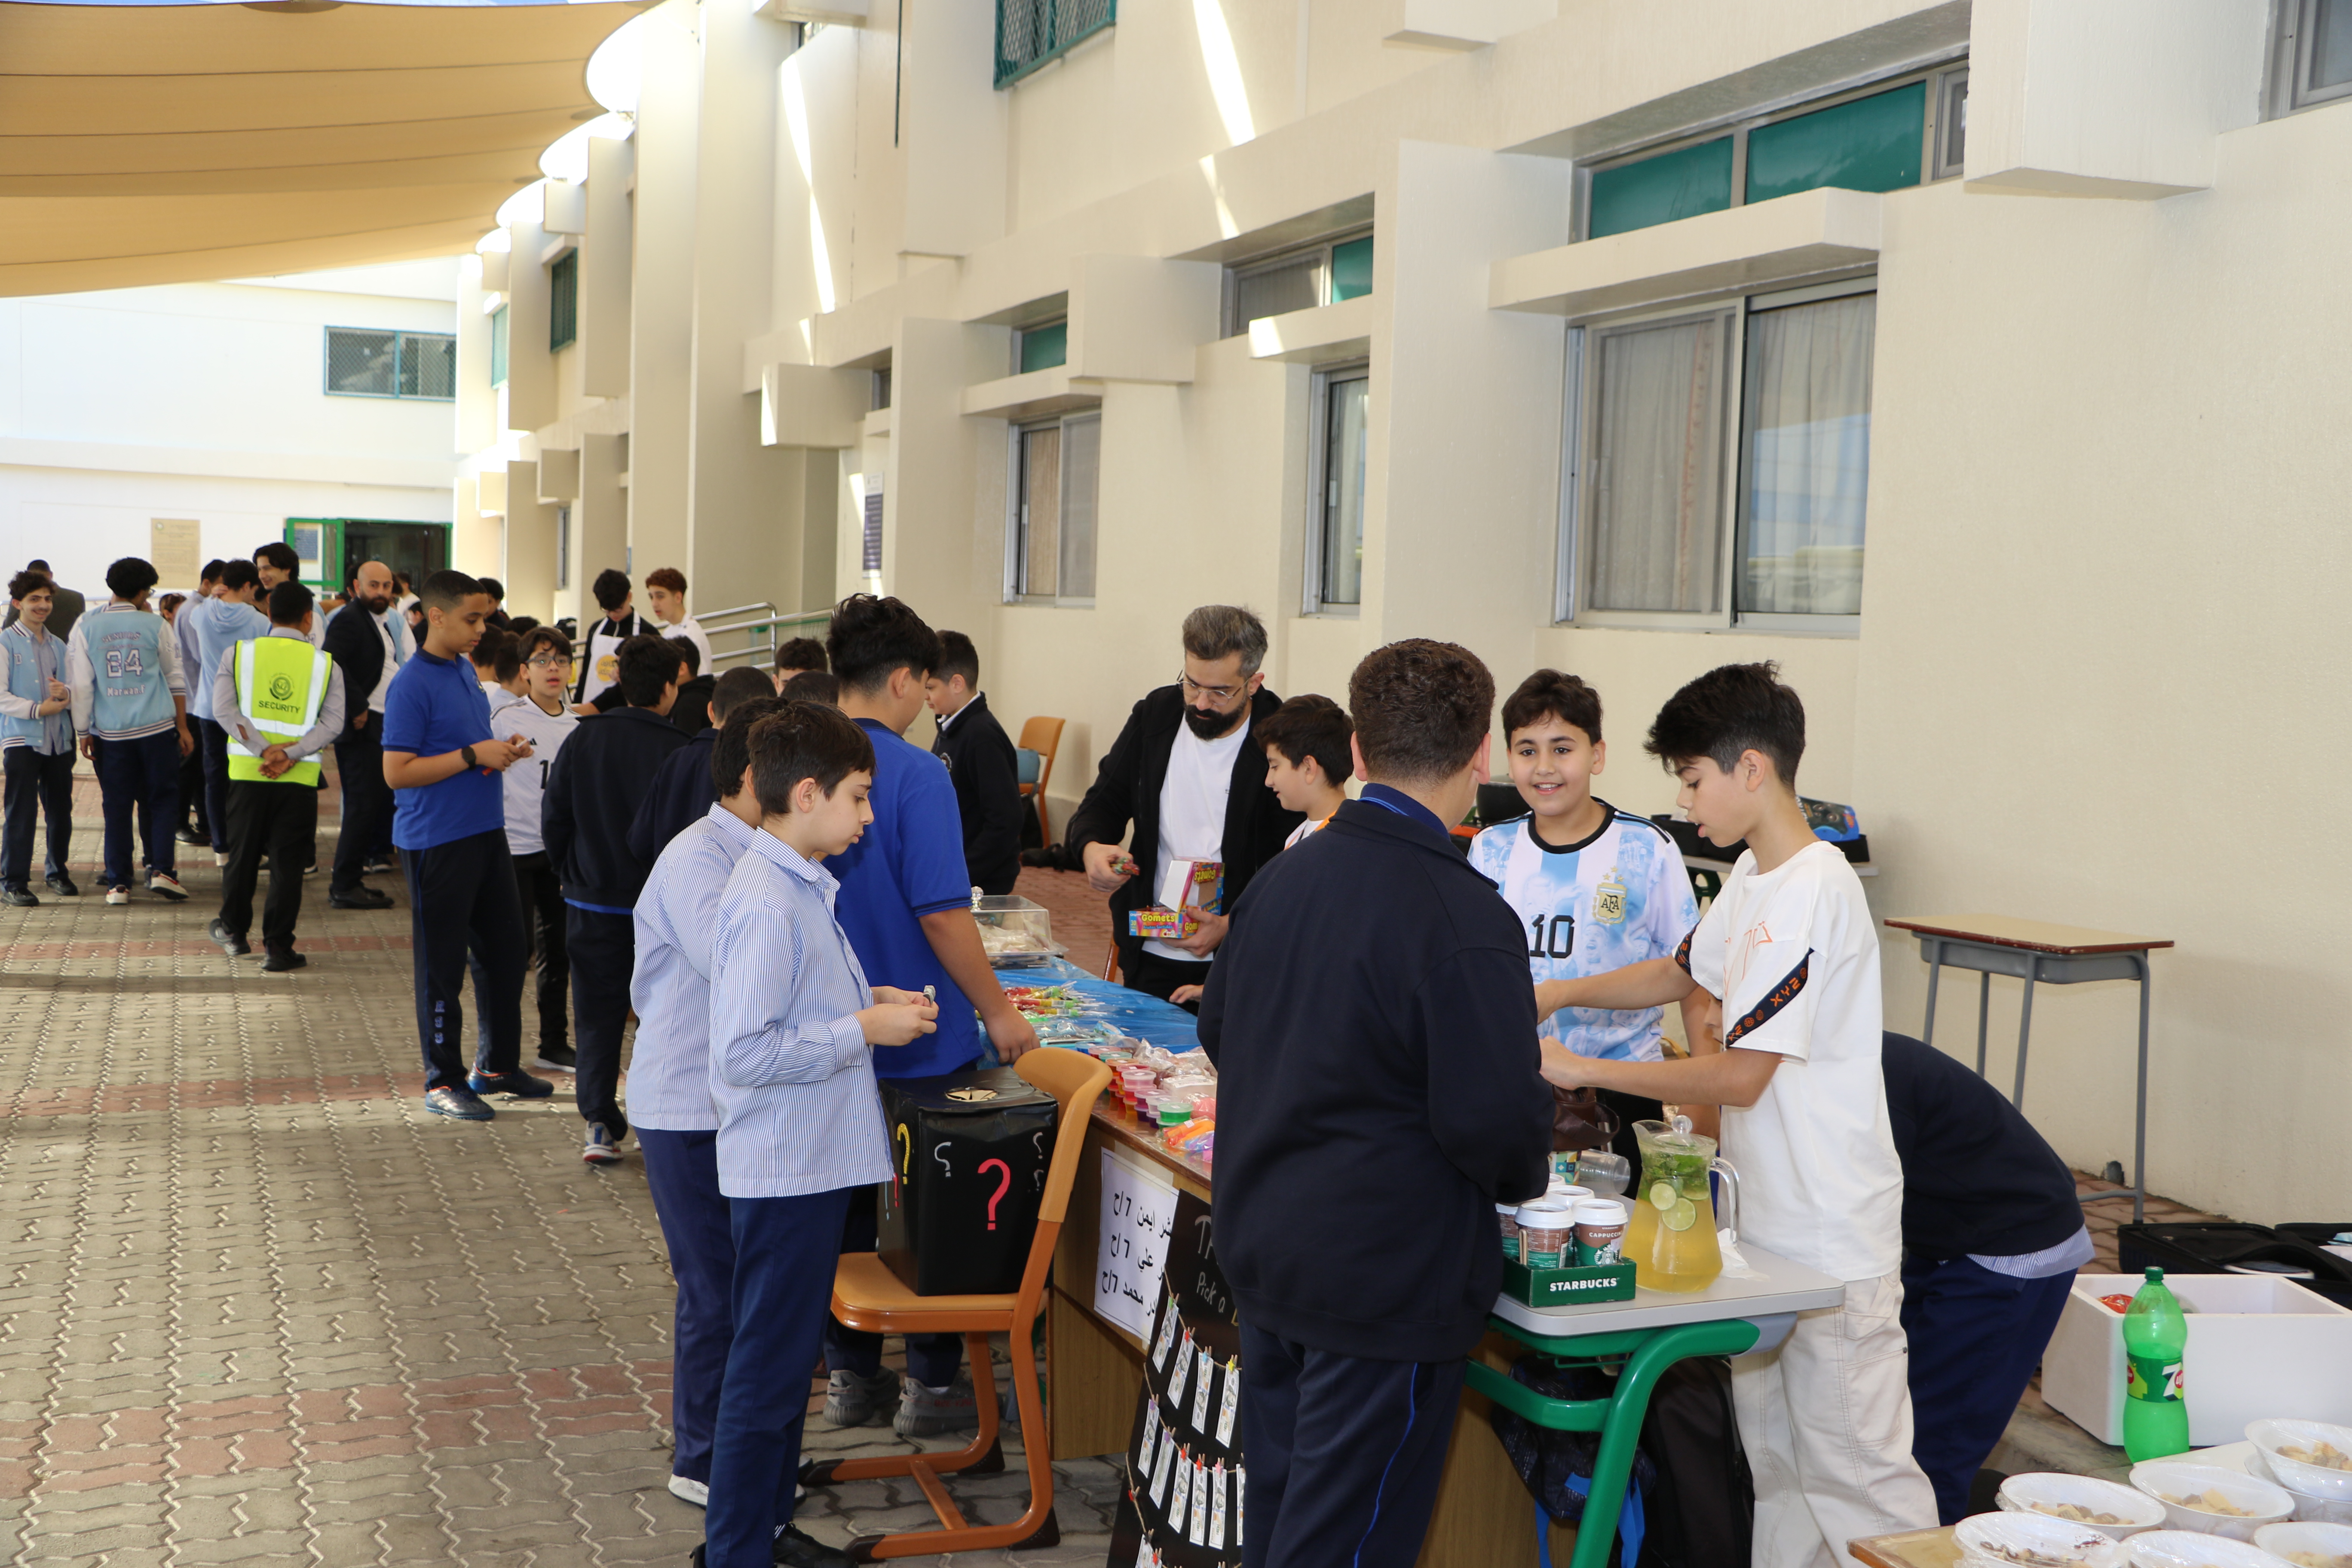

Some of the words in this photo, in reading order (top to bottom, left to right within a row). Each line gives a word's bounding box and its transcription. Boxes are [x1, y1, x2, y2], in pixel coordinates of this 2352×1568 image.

[258, 700, 300, 713] SECURITY
[1601, 894, 1620, 913] AFA
[1141, 913, 1175, 922] Gomets
[1530, 914, 1575, 959] 10
[1138, 1246, 1154, 1273] علي
[1123, 1281, 1143, 1305] محمد
[1197, 1271, 1216, 1305] Pick
[1218, 1297, 1225, 1313] a
[1550, 1278, 1617, 1291] STARBUCKS
